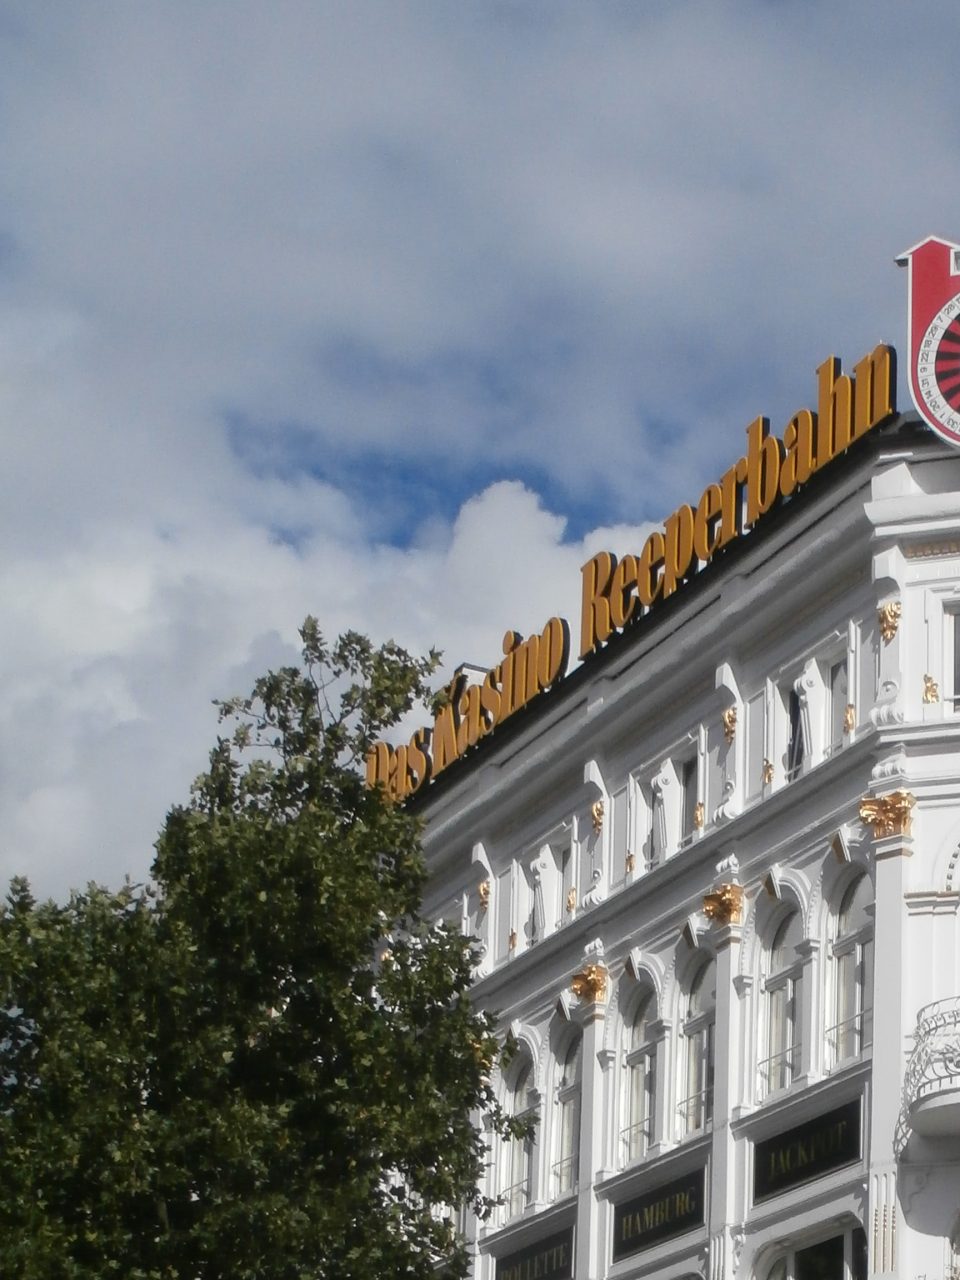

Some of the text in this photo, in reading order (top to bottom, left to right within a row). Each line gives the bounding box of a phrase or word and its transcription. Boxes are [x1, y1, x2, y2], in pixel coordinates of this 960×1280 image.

[432, 615, 570, 780] Kasino
[579, 341, 897, 659] Reeperbahn
[768, 1120, 847, 1181] JACKPOT
[622, 1187, 696, 1241] HAMBURG
